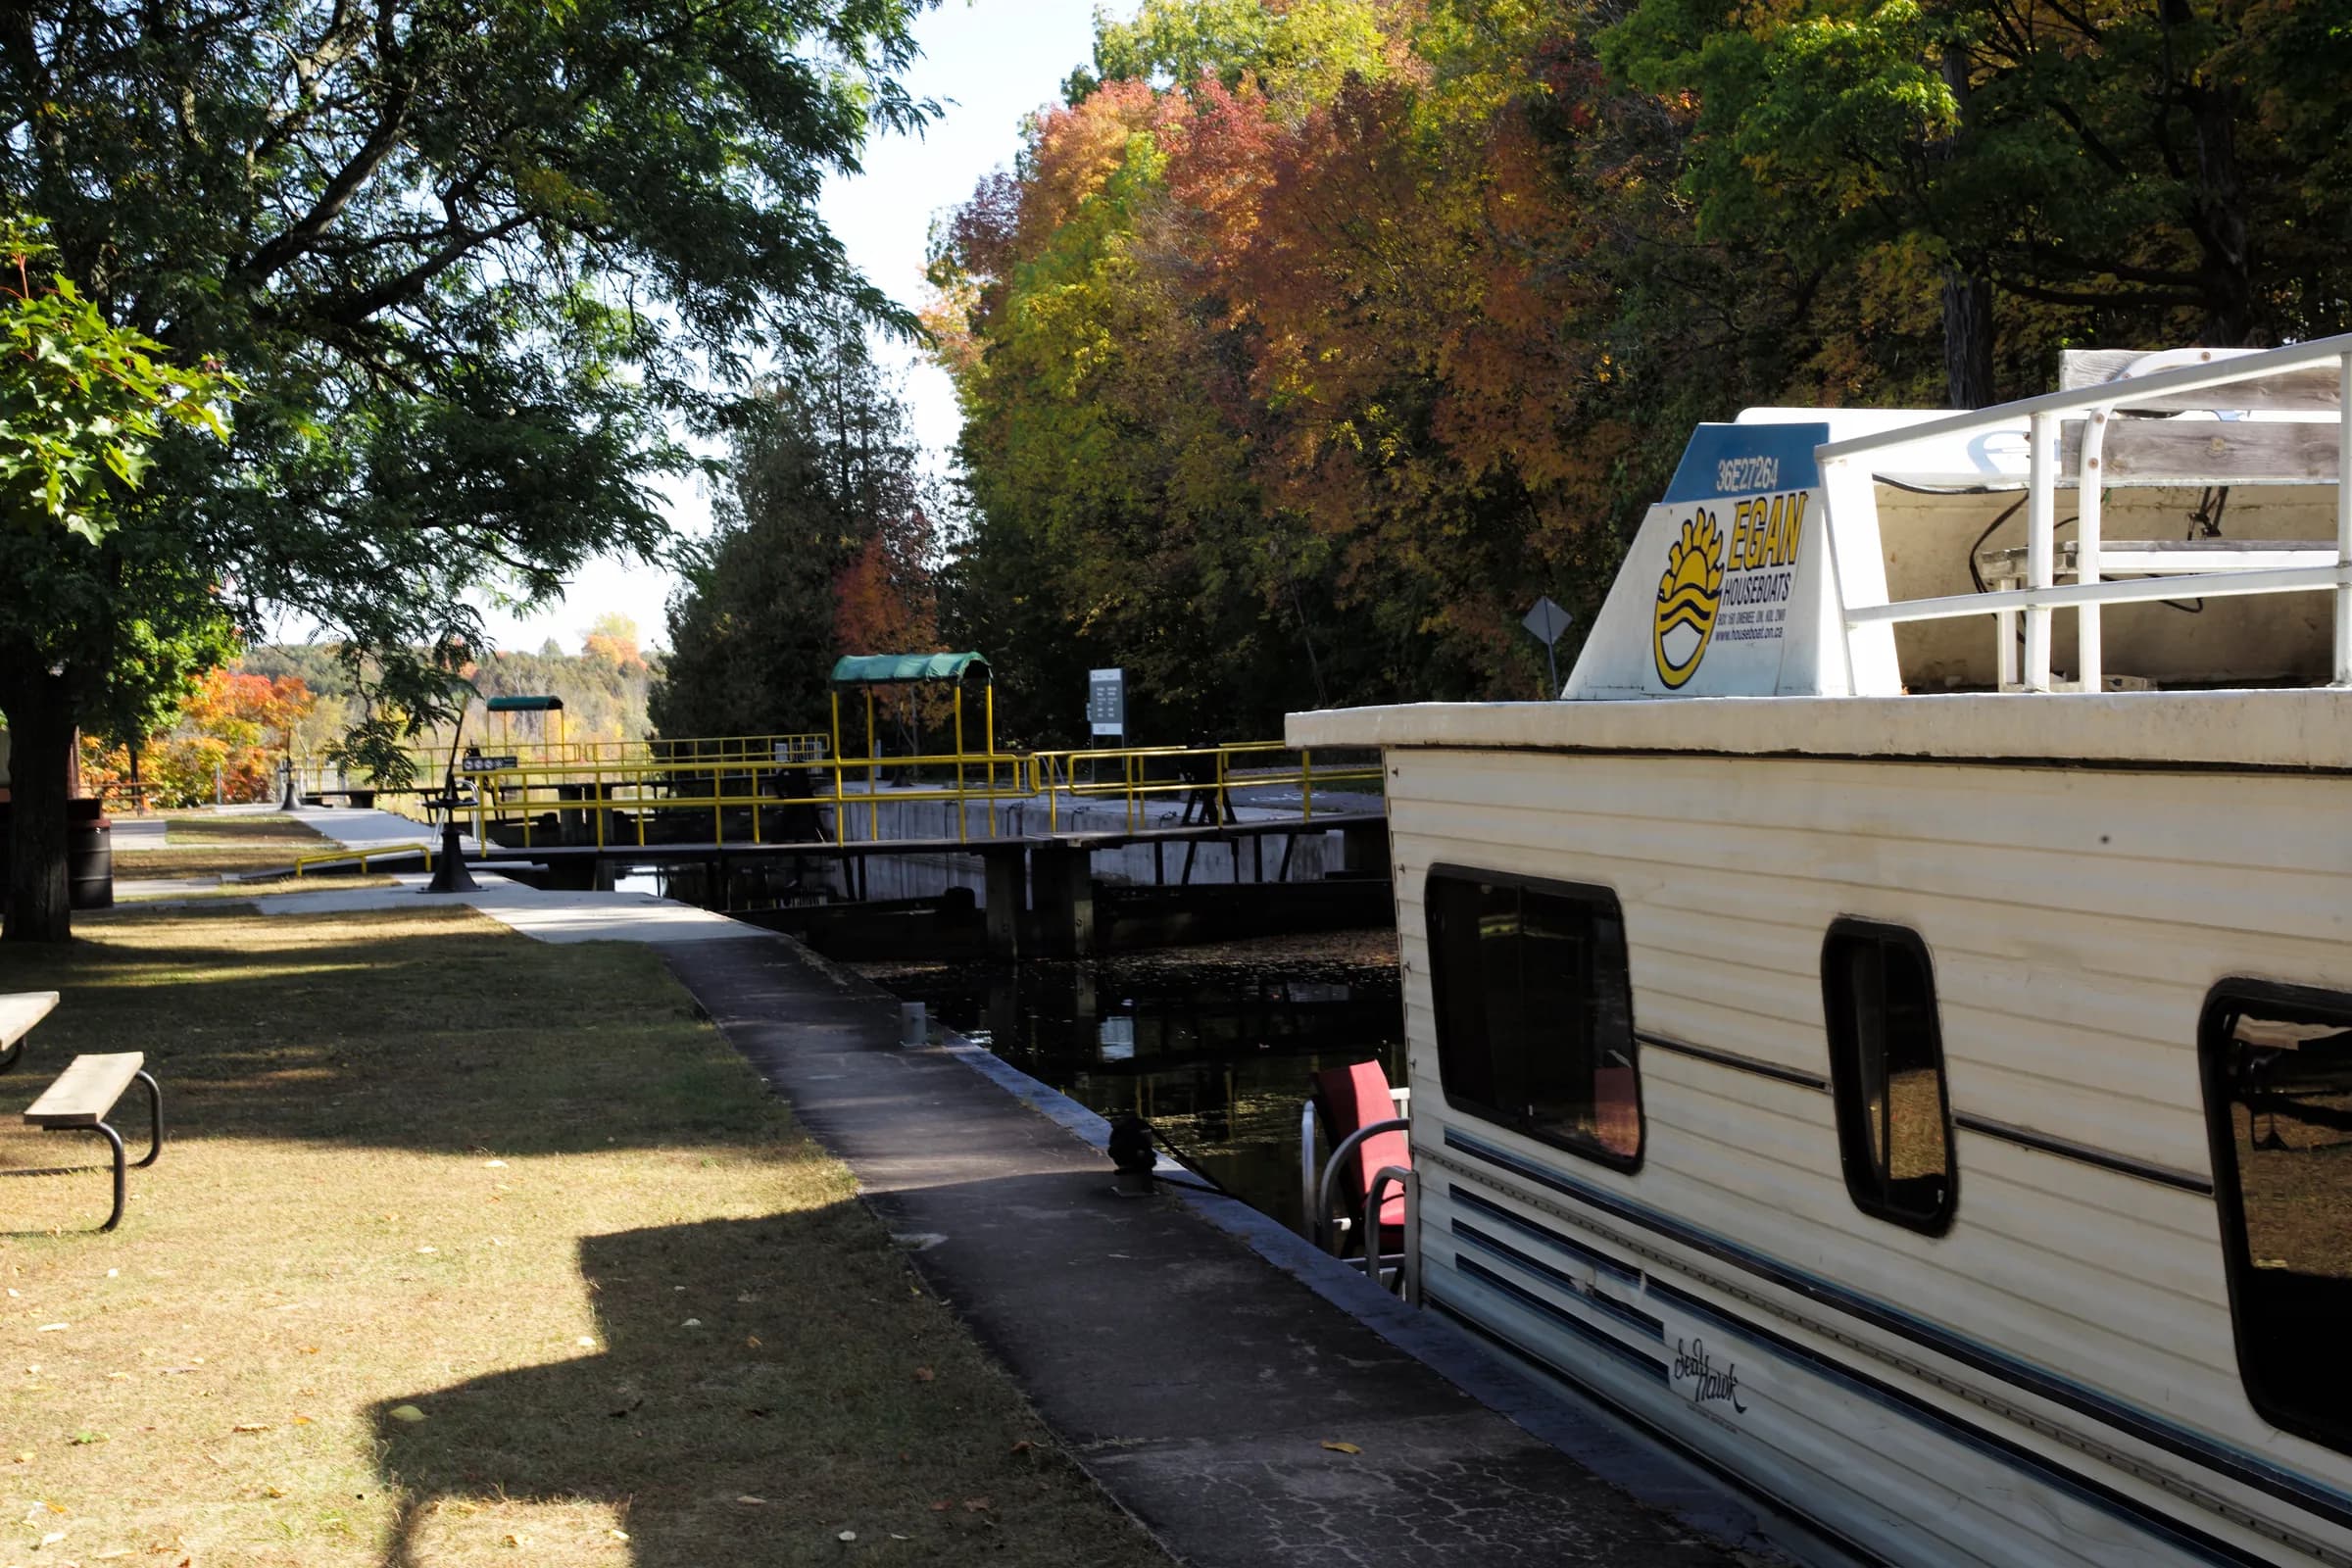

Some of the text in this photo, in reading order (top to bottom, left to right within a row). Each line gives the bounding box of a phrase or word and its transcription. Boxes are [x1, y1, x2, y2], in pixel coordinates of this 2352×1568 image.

[1716, 456, 1779, 491] 36E27264
[1727, 491, 1808, 571] EGAN
[1722, 572, 1791, 606] HOUSEBOATS
[1715, 626, 1783, 641] www.houseboat.on.ca
